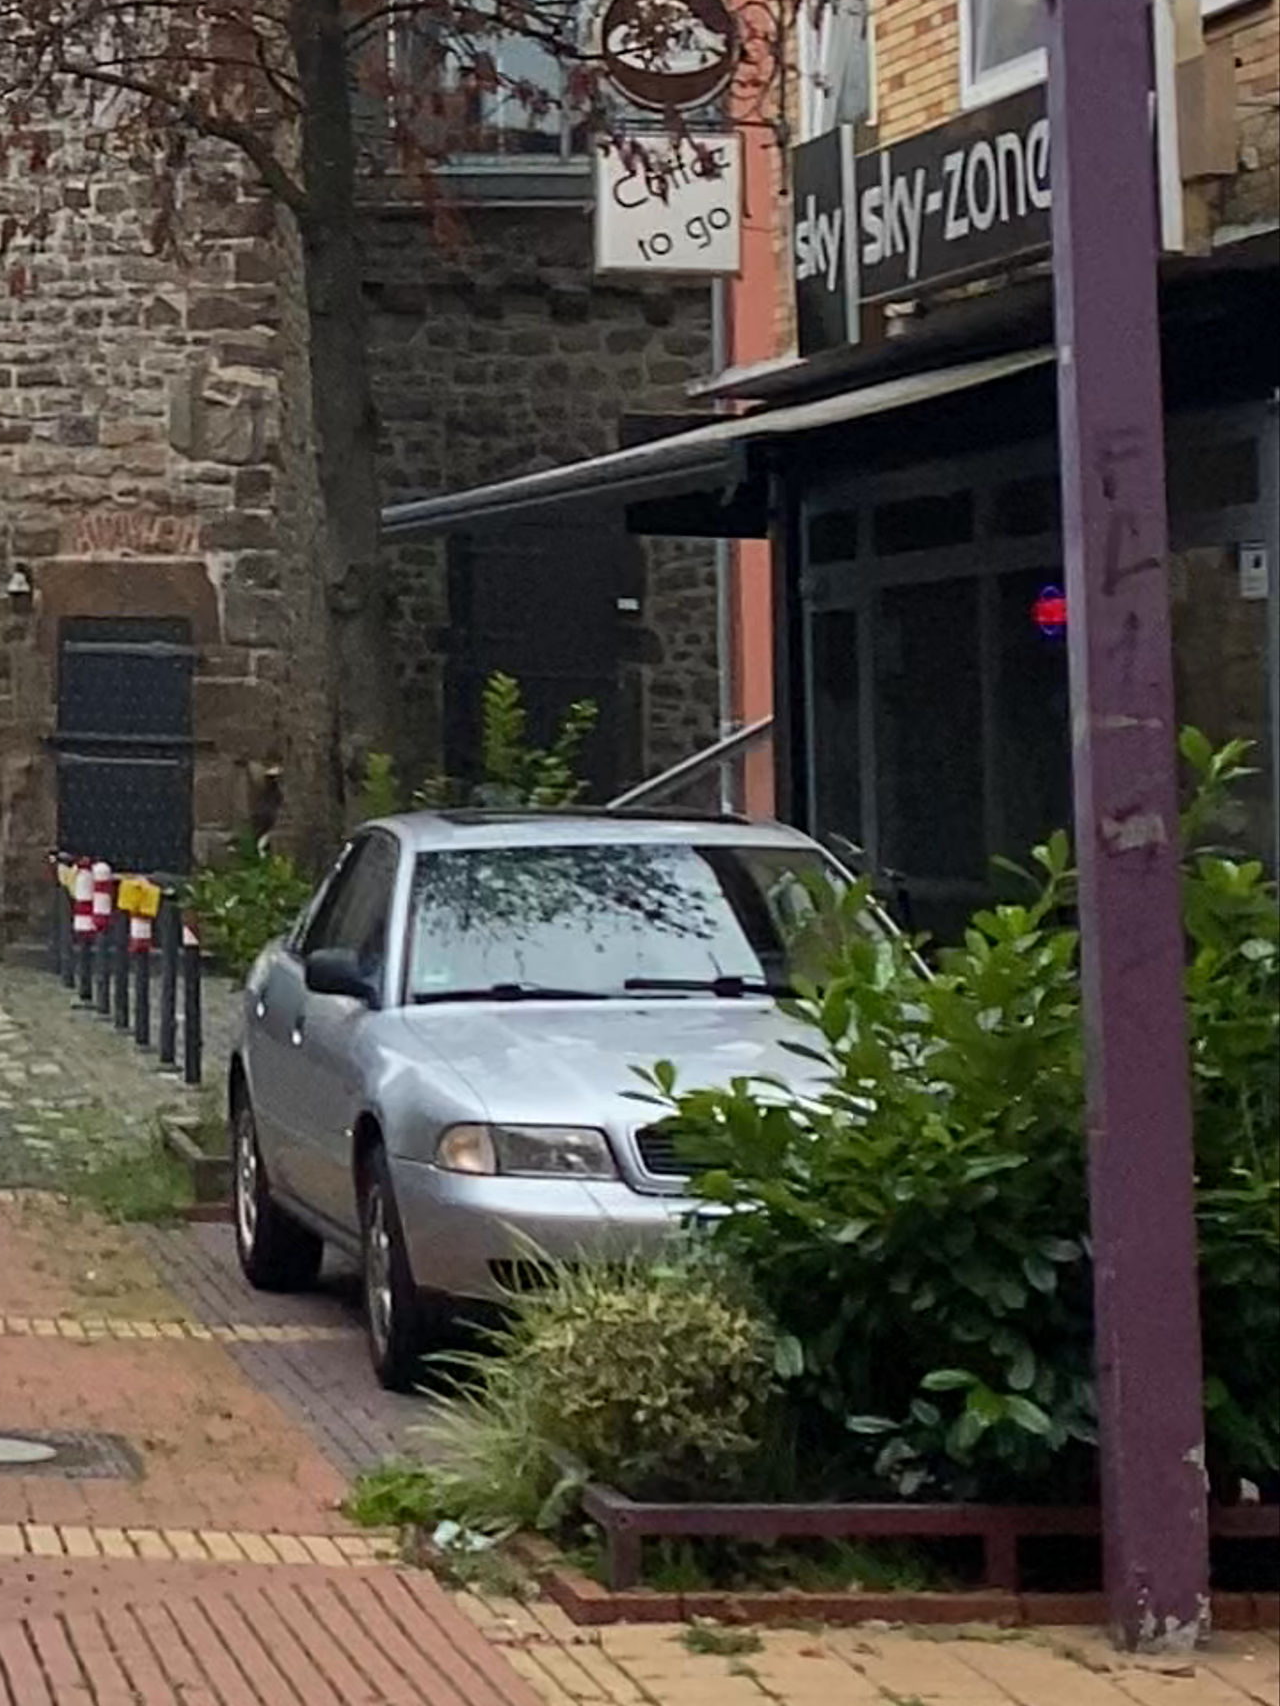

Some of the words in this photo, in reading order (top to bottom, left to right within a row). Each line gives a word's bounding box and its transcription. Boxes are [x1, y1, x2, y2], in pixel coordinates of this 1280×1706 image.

[638, 233, 673, 261] to
[685, 207, 731, 248] go
[796, 194, 842, 292] sky
